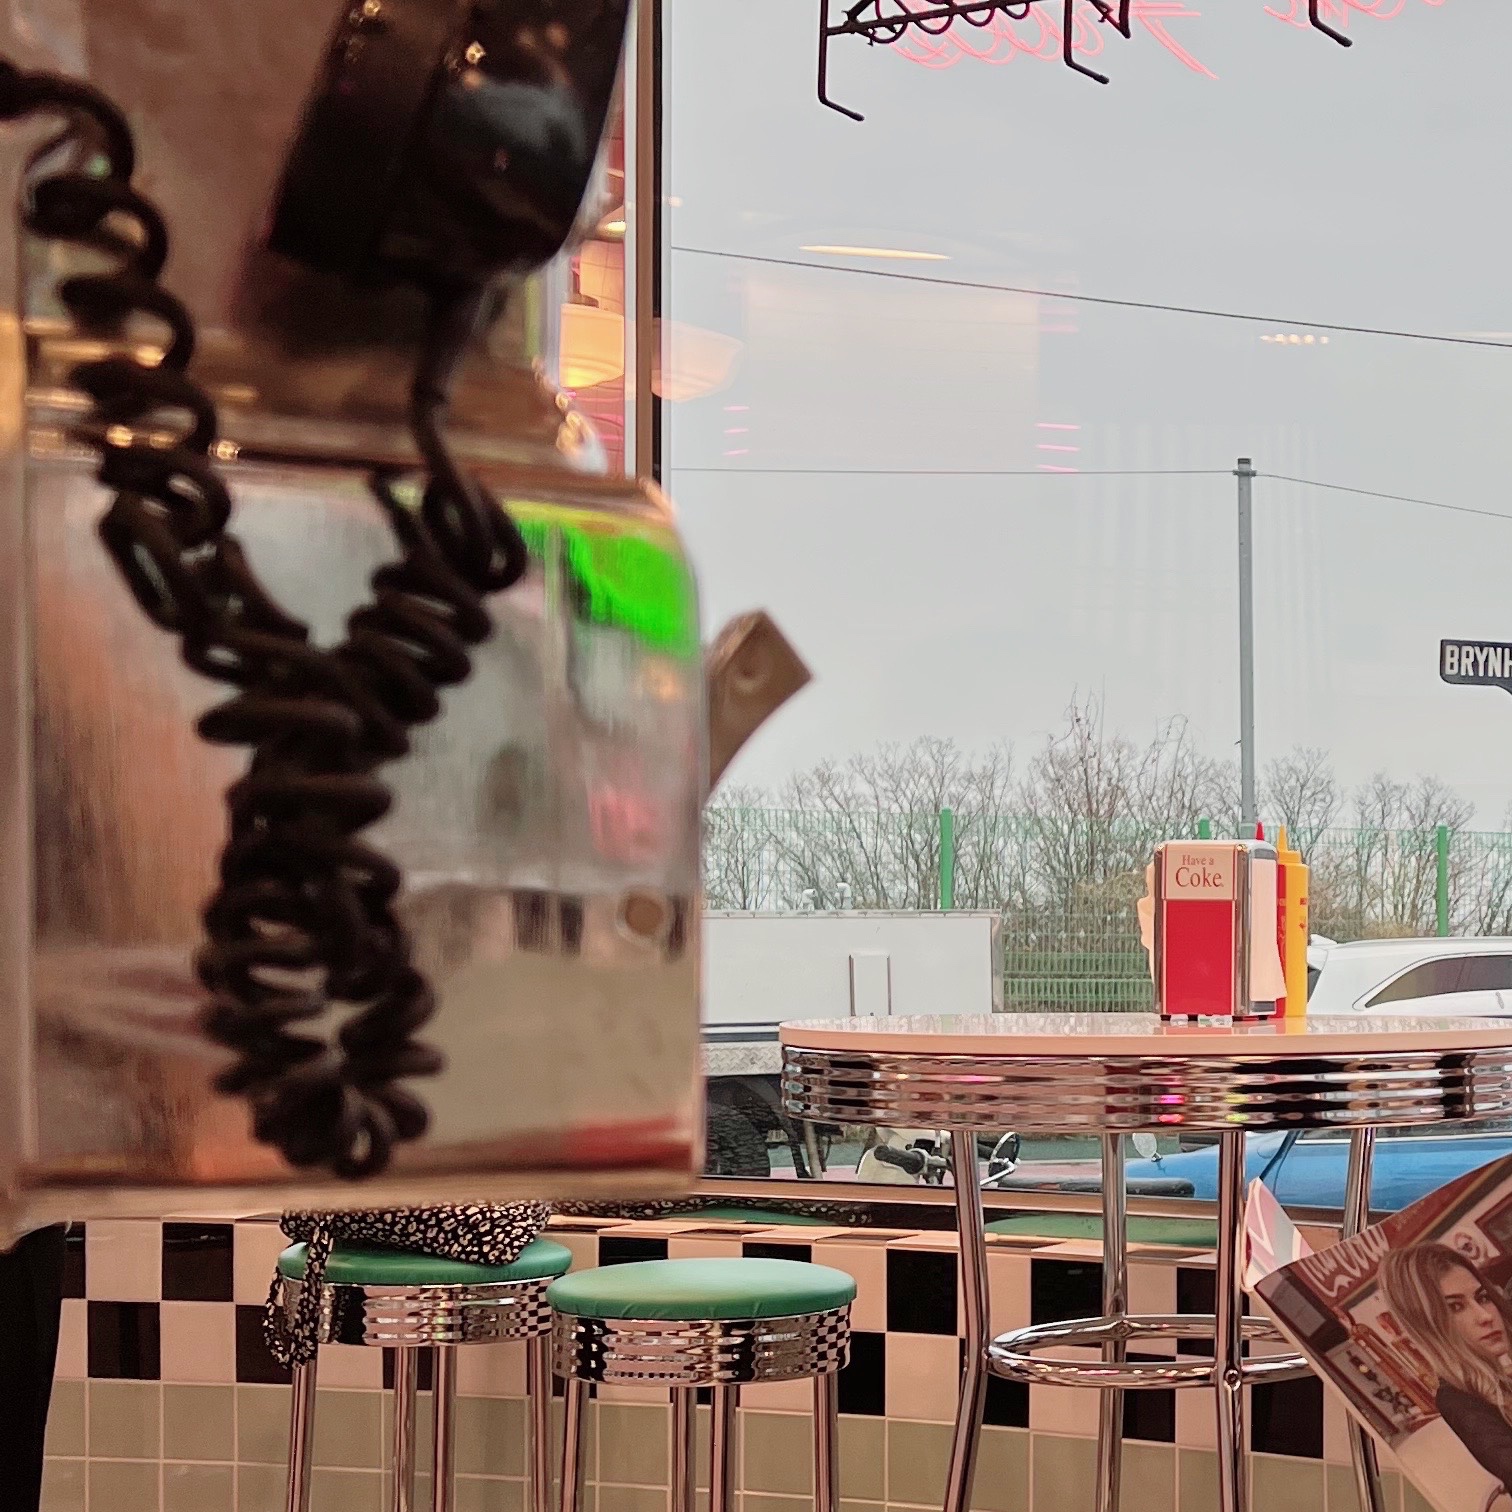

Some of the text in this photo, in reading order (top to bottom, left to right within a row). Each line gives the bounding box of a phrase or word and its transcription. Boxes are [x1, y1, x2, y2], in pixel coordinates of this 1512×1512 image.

[1182, 855, 1214, 866] Have a
[1175, 867, 1222, 888] Coke
